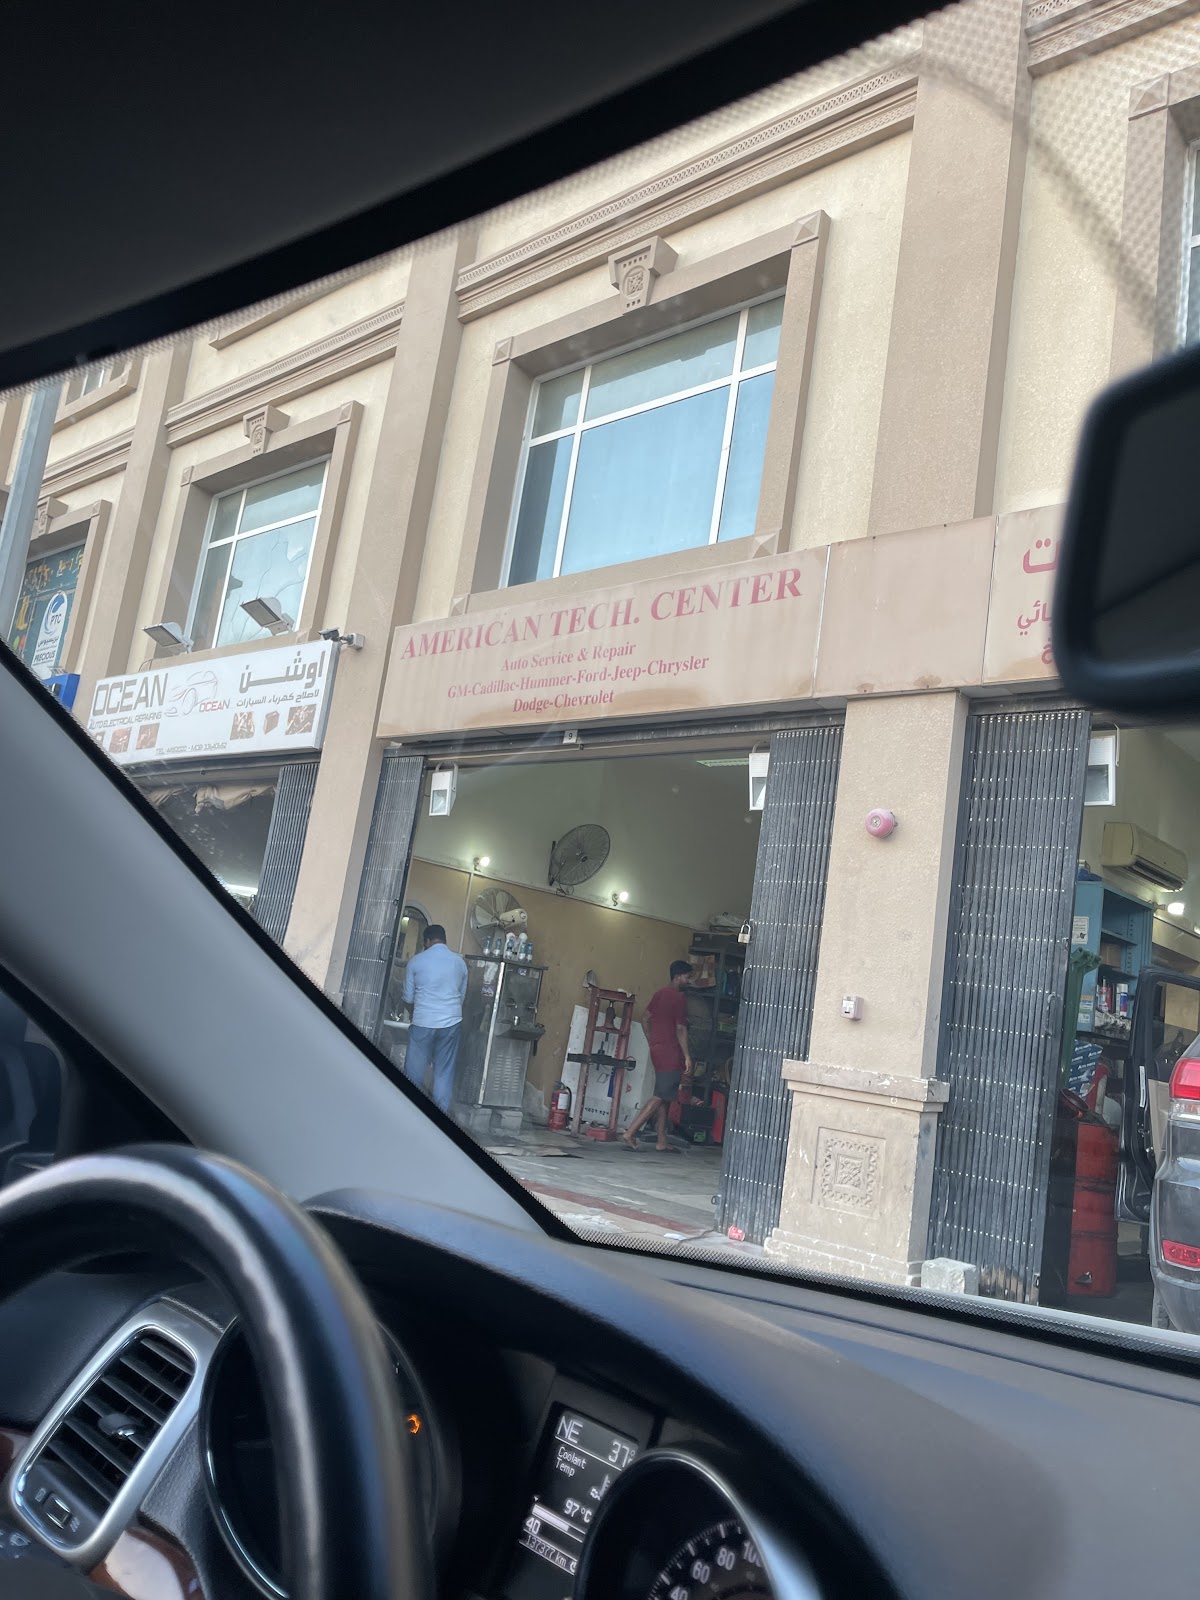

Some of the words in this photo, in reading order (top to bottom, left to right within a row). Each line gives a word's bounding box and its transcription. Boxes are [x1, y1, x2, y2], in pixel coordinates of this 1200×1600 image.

[49, 613, 62, 626] PTC
[400, 614, 544, 660] AMERICAN
[550, 597, 640, 637] TECH.
[650, 568, 804, 621] CENTER
[34, 650, 56, 662] PRECIOUS
[501, 656, 529, 672] Auto
[530, 650, 574, 669] Service
[577, 647, 589, 662] &
[592, 641, 637, 661] Repair
[92, 672, 169, 717] OCEAN
[199, 699, 231, 713] OCEAN
[512, 689, 615, 714] Dodge-Chevrolet
[556, 1415, 584, 1444] NE
[554, 1457, 575, 1477] Temp
[558, 1446, 587, 1469] Coolant
[526, 1535, 556, 1559] 137377
[555, 1551, 567, 1567] km
[716, 1547, 736, 1571] 80
[692, 1561, 711, 1585] 60
